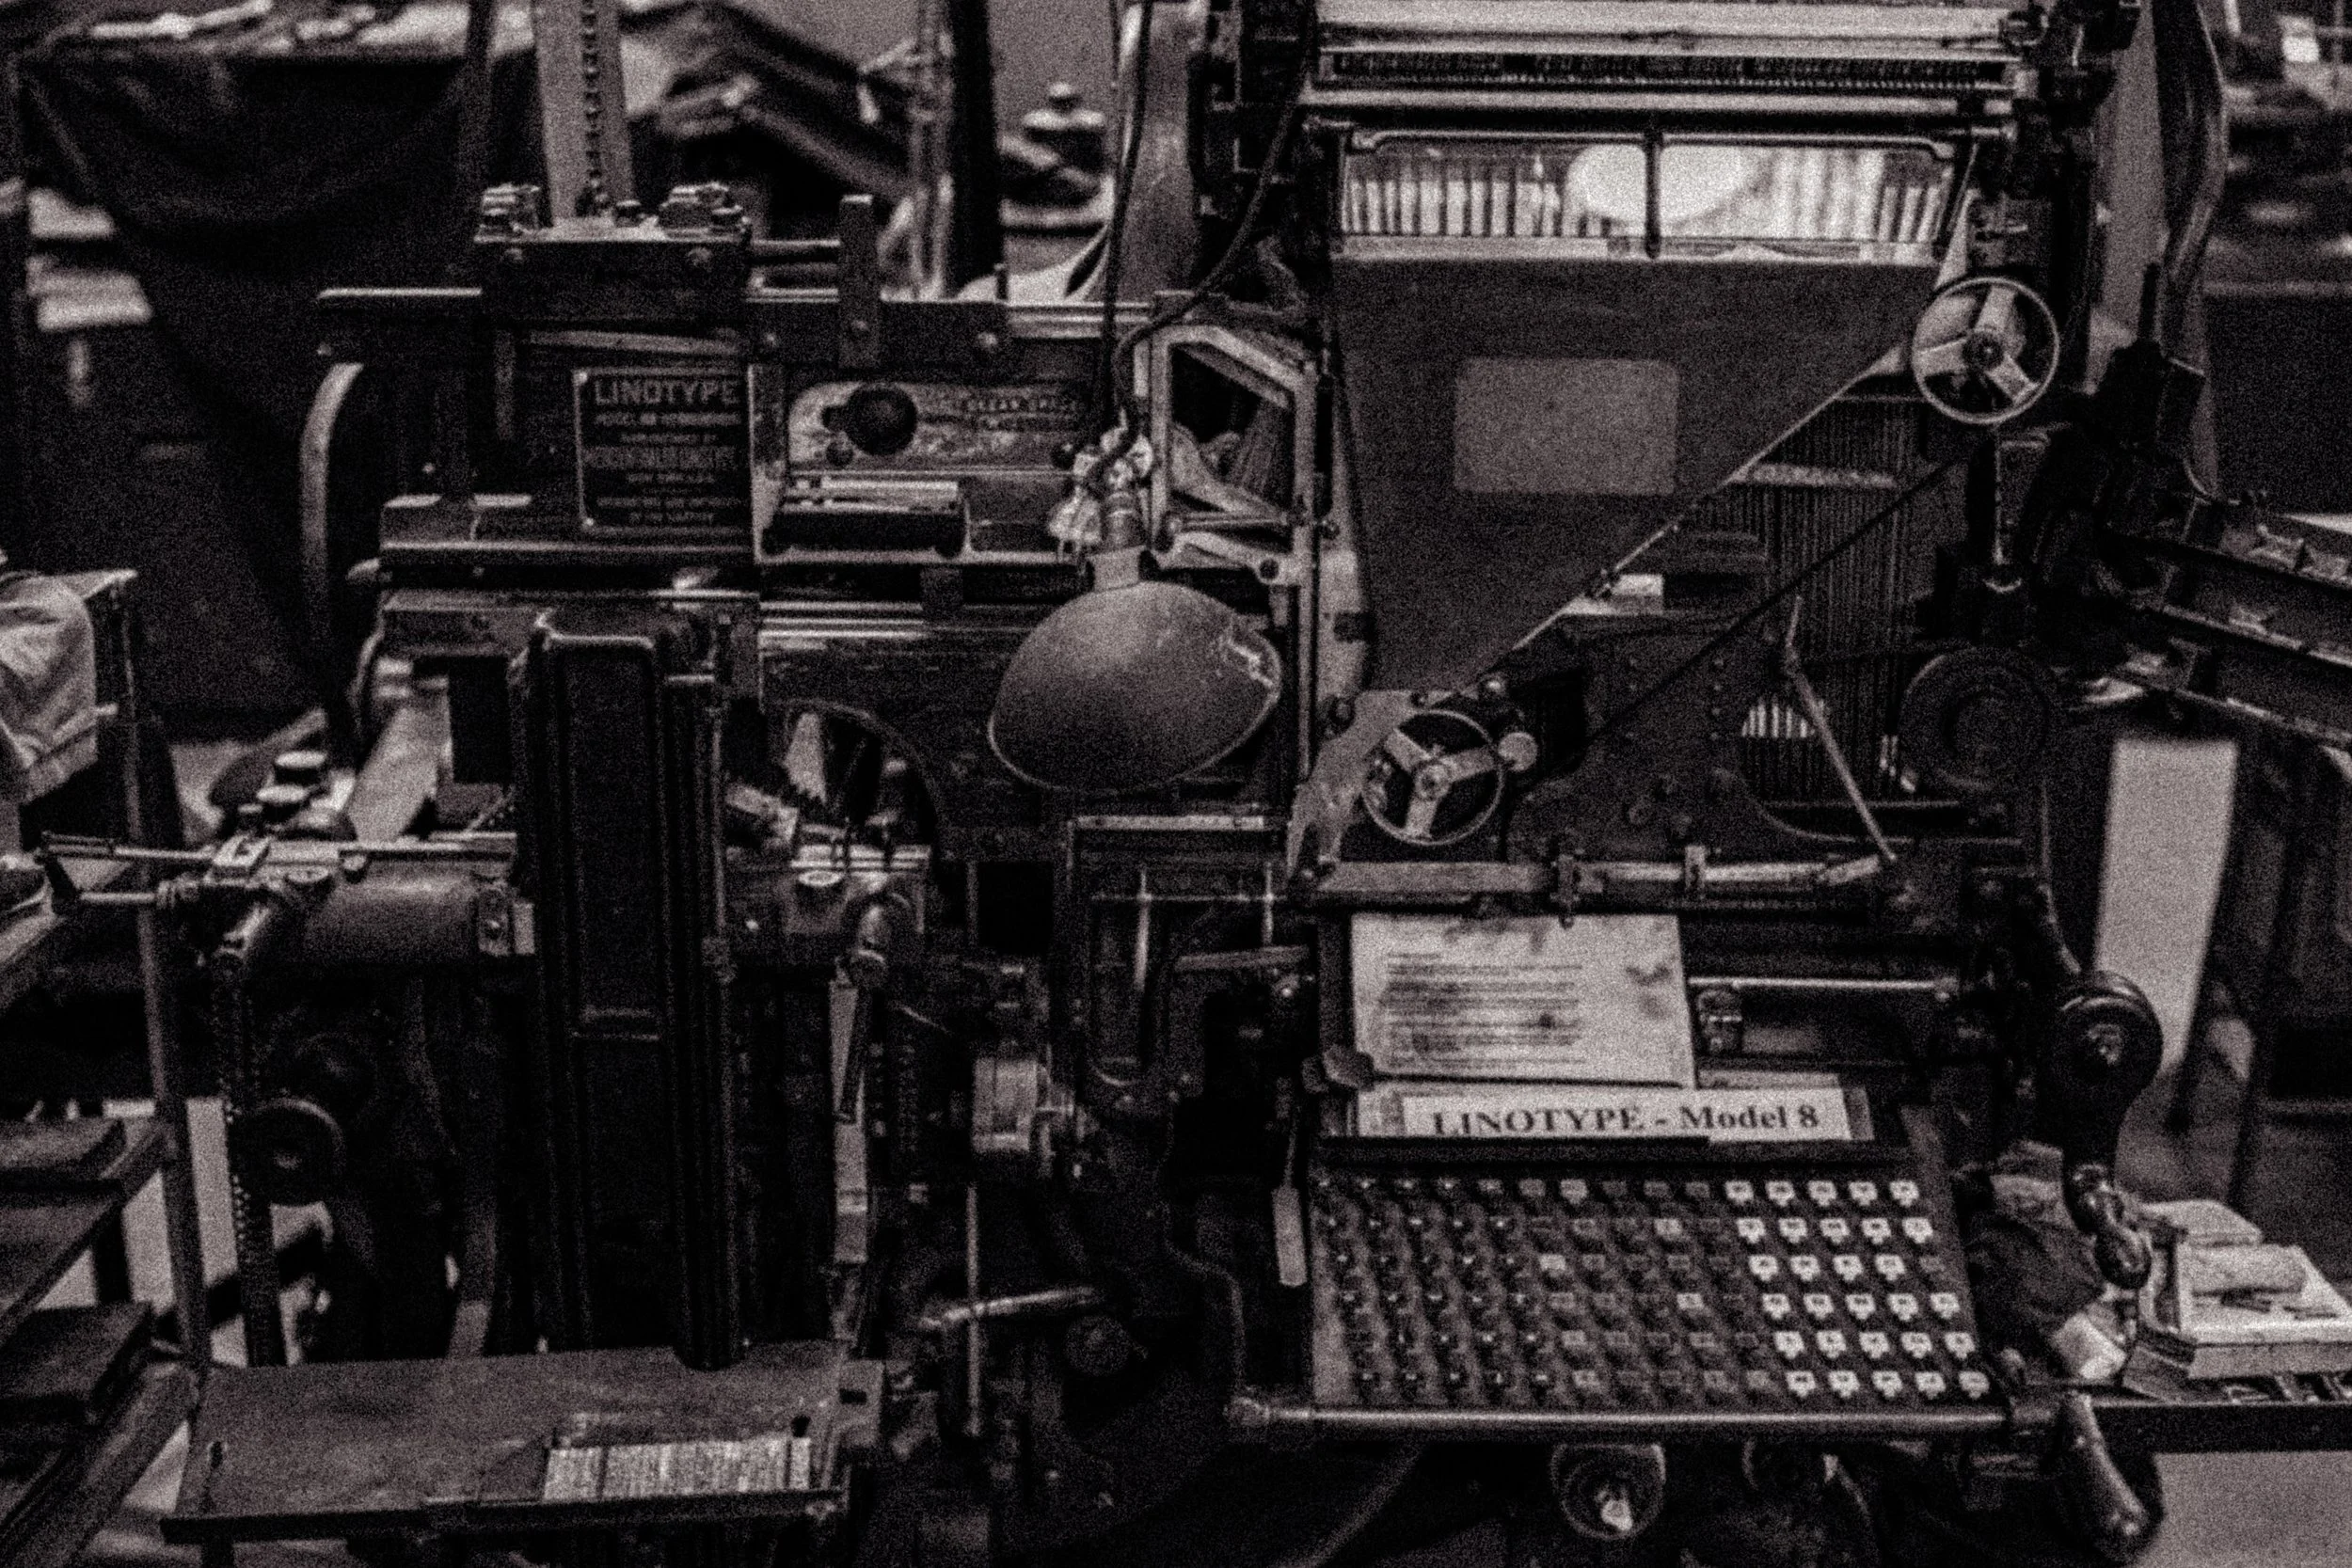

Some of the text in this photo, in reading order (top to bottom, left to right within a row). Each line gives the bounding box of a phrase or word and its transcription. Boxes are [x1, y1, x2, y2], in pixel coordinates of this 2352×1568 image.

[594, 380, 740, 404] LINOTYPE
[1432, 1106, 1645, 1136] LINOTYPE
[1679, 1104, 1788, 1132] Model
[1797, 1105, 1820, 1131] 8
